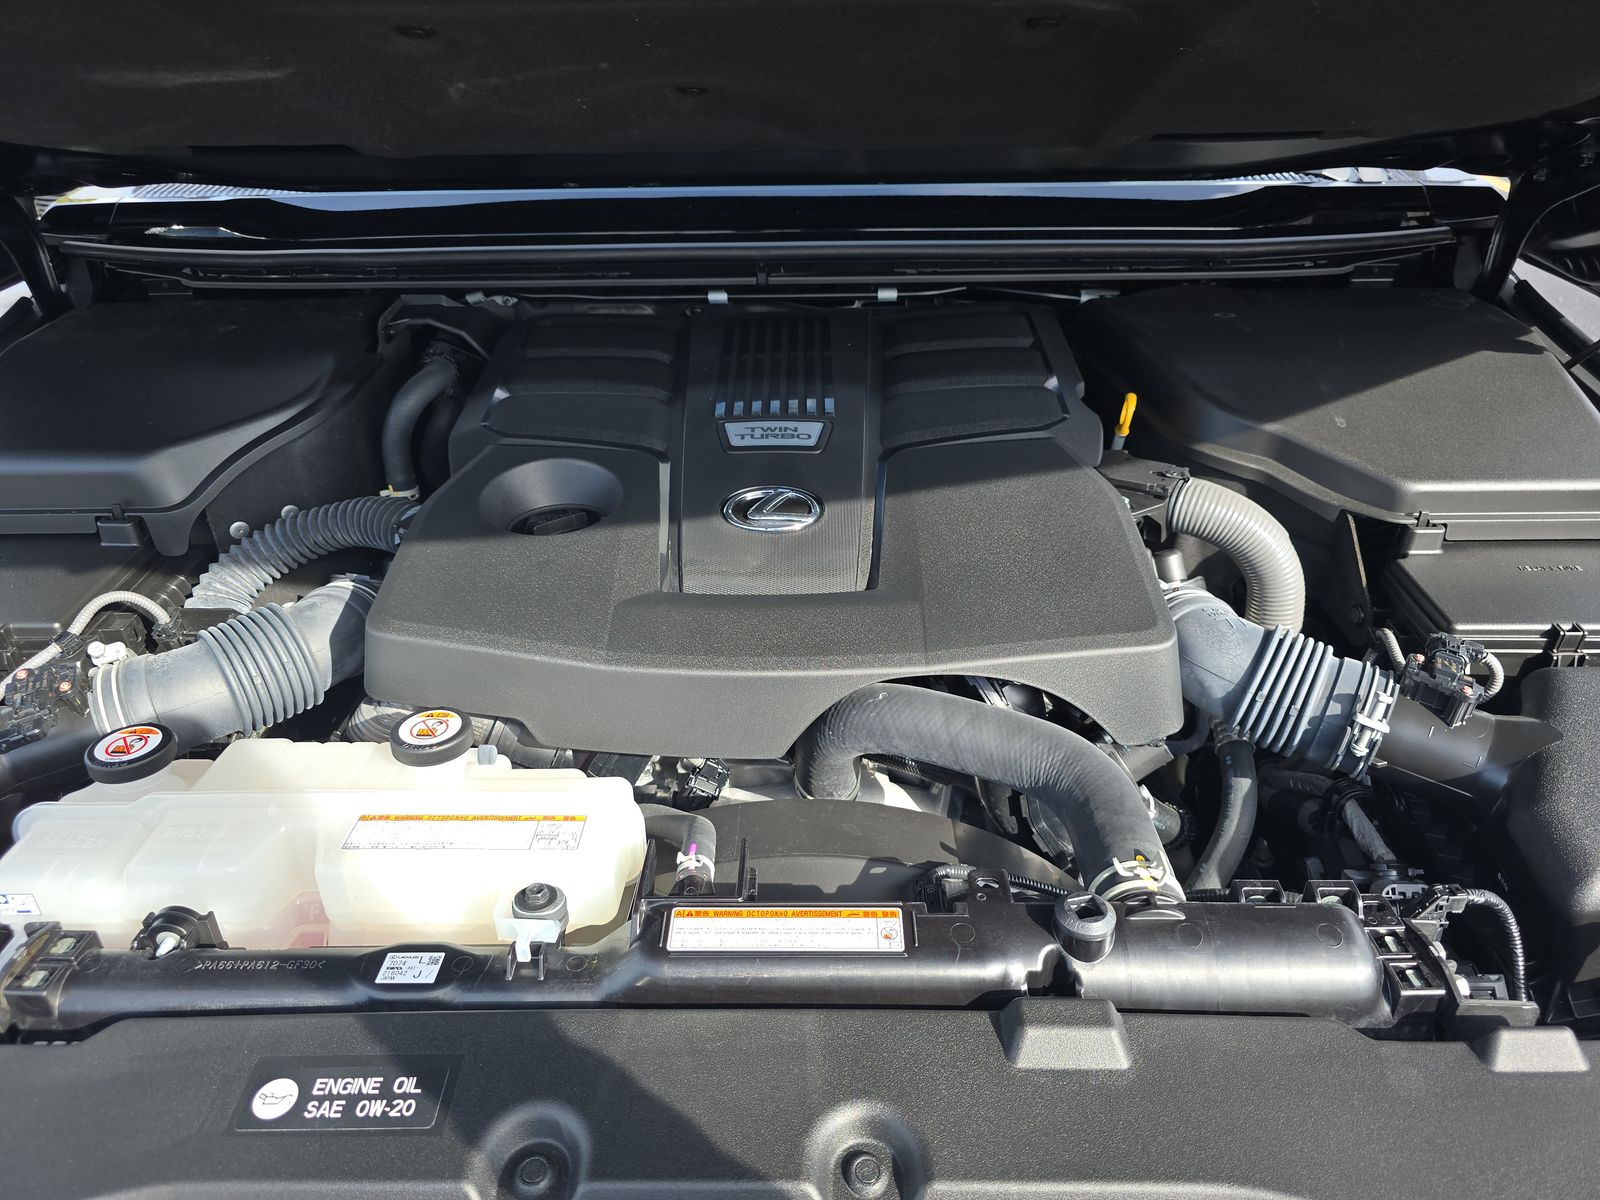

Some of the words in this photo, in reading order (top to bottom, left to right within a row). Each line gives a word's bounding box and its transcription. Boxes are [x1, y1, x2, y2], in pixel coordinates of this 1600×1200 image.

[312, 1077, 383, 1095] ENGINE
[392, 1076, 422, 1094] OIL
[303, 1100, 346, 1118] SAE
[355, 1099, 417, 1117] 0W-20
